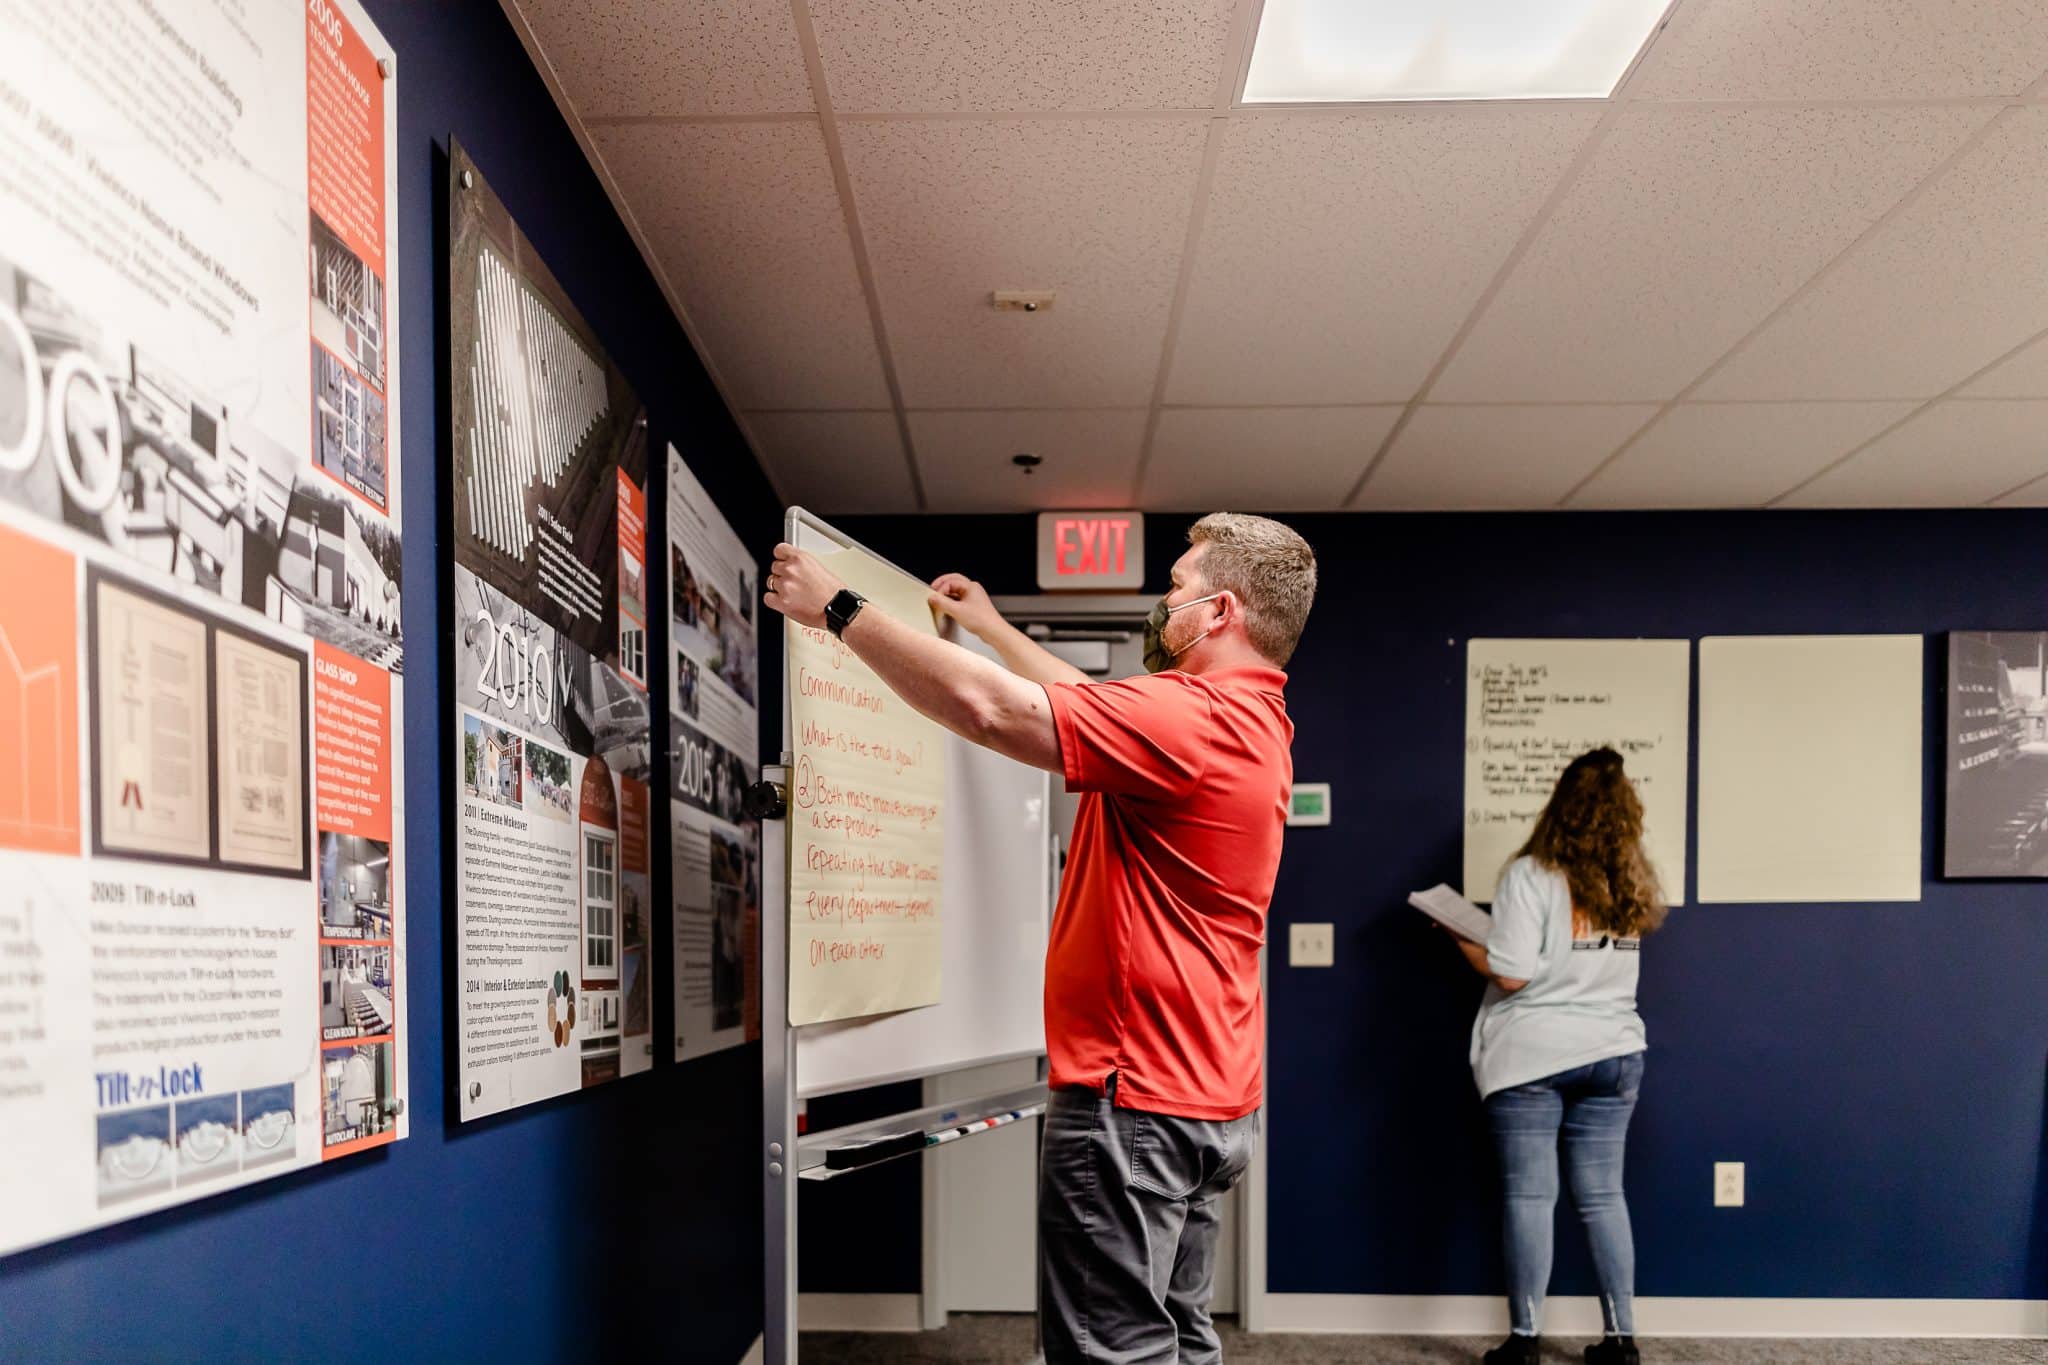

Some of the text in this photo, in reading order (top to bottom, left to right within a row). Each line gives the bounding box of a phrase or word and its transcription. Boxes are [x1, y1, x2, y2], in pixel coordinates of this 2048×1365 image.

[310, 0, 342, 47] 2006
[310, 19, 339, 67] TESTING
[339, 58, 370, 108] IN-HOUSE
[359, 362, 370, 380] TEST
[346, 471, 385, 508] IMPACT TESTING
[1056, 519, 1130, 576] EXIT
[315, 656, 357, 685] GLASS SHOP
[476, 608, 551, 726] 2010
[800, 667, 884, 713] Communication
[802, 719, 834, 747] What
[850, 735, 868, 756] the
[677, 735, 713, 804] 2015
[817, 775, 842, 805] Both
[464, 802, 527, 833] 2011 Extreme Makeover
[808, 843, 865, 892] repeating
[135, 884, 196, 908] Tilt-n-Lock
[806, 890, 843, 928] every
[830, 940, 856, 963] each
[859, 935, 885, 961] other
[466, 979, 547, 992] 2014 Interior & Exterior Laminates
[324, 1025, 357, 1041] CLEAN ROOM
[96, 1062, 204, 1108] Tilt-n-Lock
[326, 1129, 356, 1147] AUTOCLAVE
